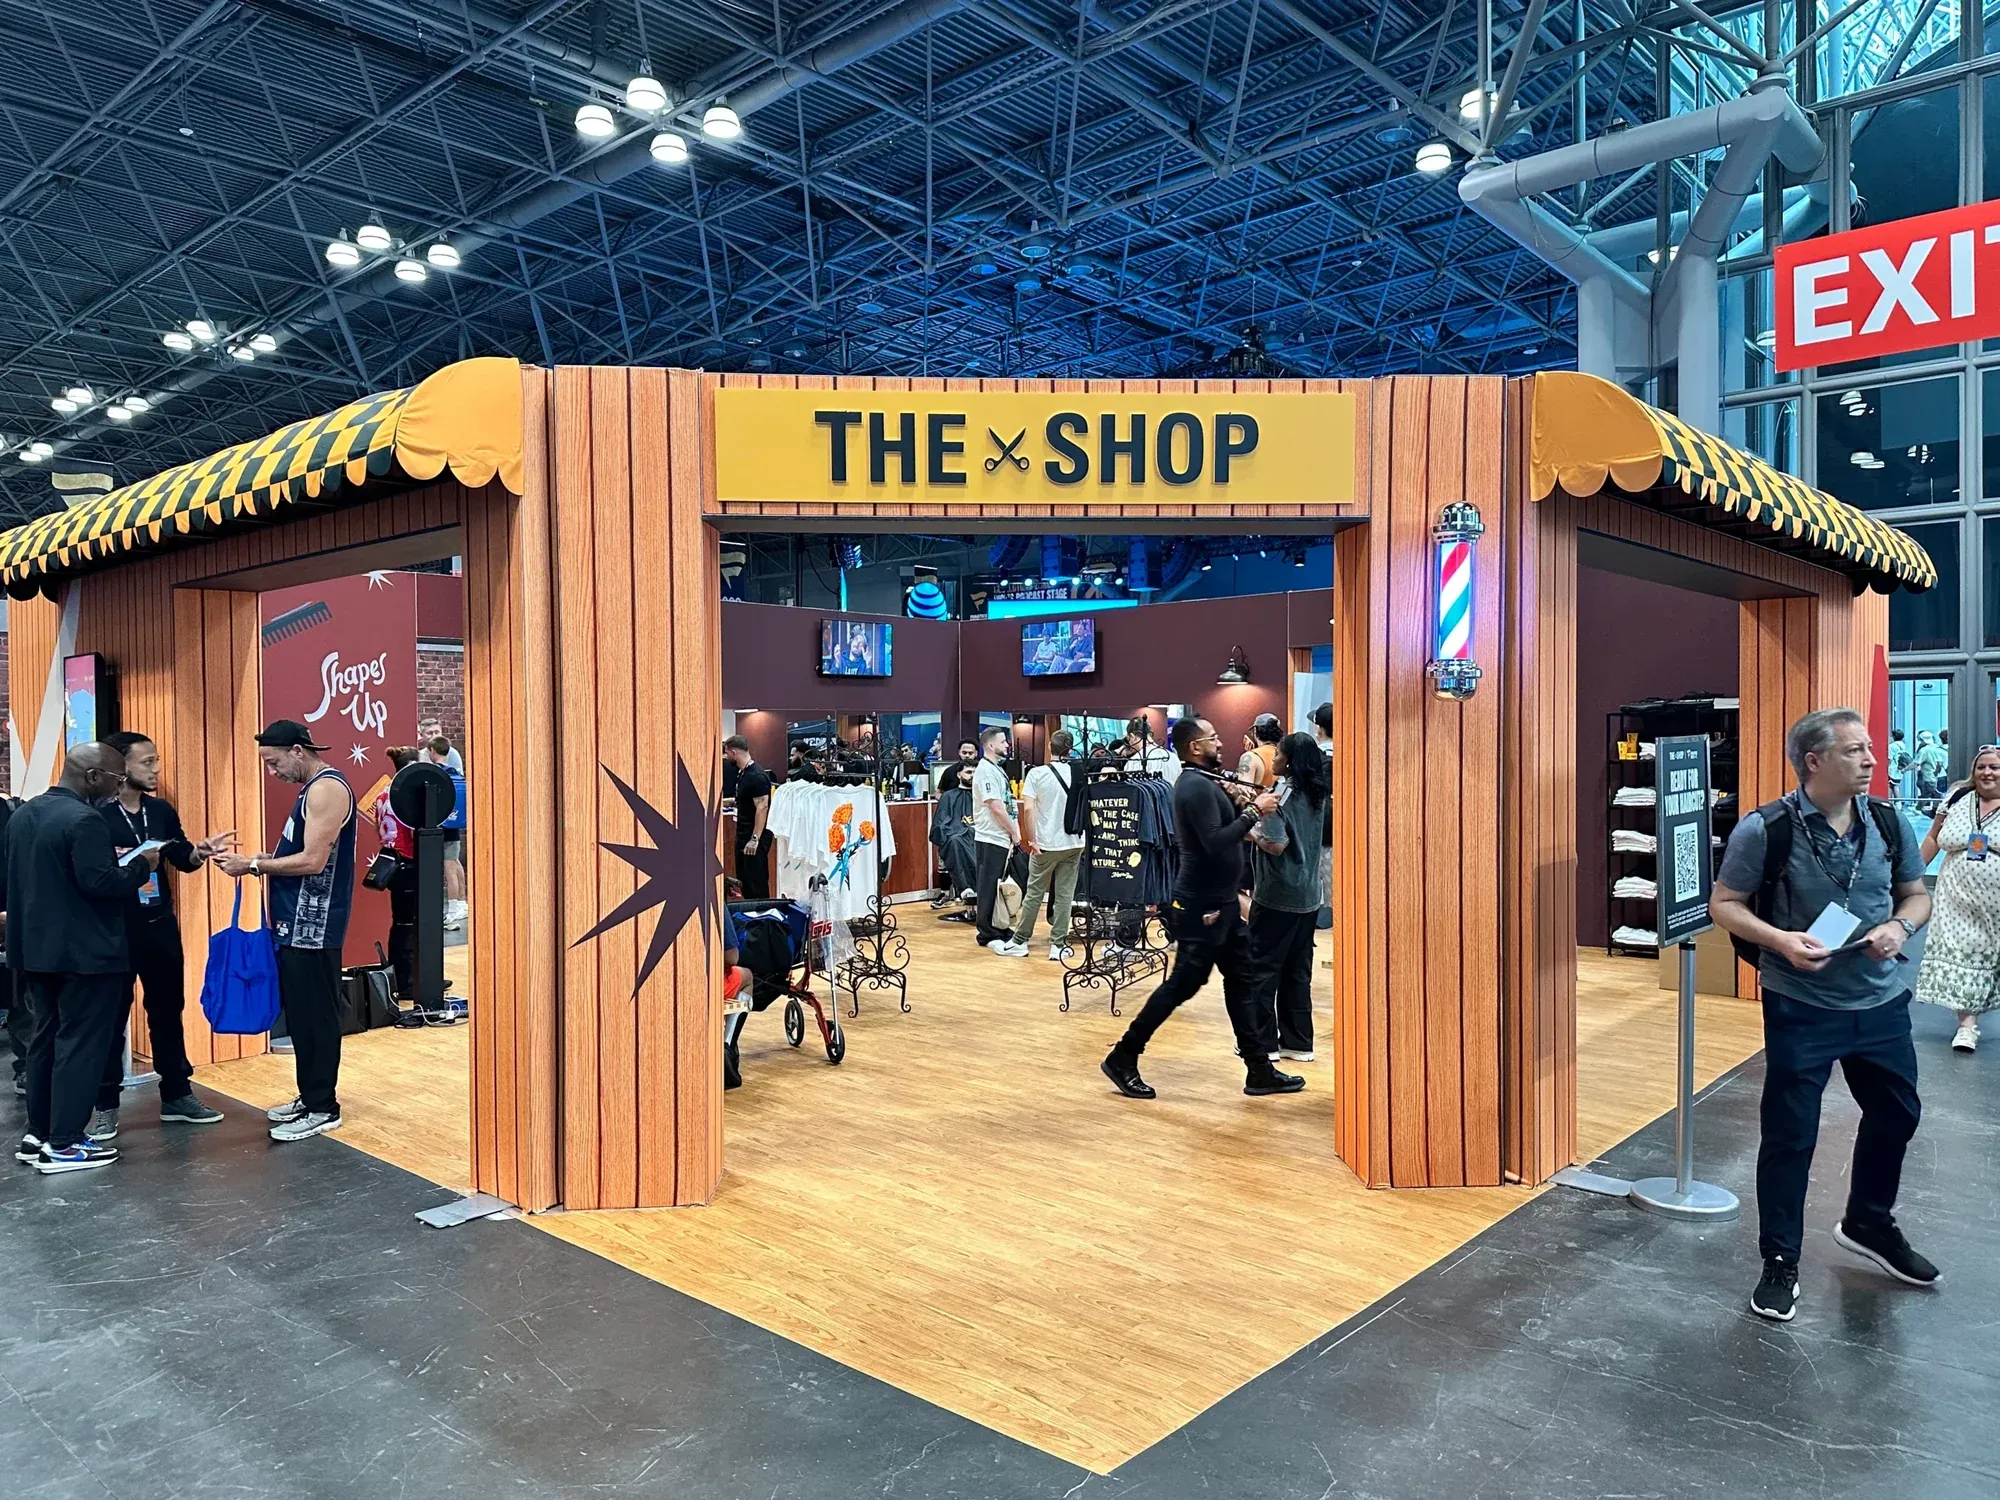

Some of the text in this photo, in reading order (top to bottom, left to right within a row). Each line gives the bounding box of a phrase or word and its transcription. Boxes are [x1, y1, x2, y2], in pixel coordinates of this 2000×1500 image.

[1793, 224, 2000, 347] EXI
[814, 410, 1260, 486] THE SHOP
[303, 651, 387, 723] Shapes
[339, 691, 388, 739] Up
[1687, 768, 1699, 790] FOR
[1103, 809, 1139, 821] THE CASE
[1665, 793, 1679, 817] YOUR
[1103, 820, 1118, 830] MAY
[1104, 847, 1123, 858] THAT
